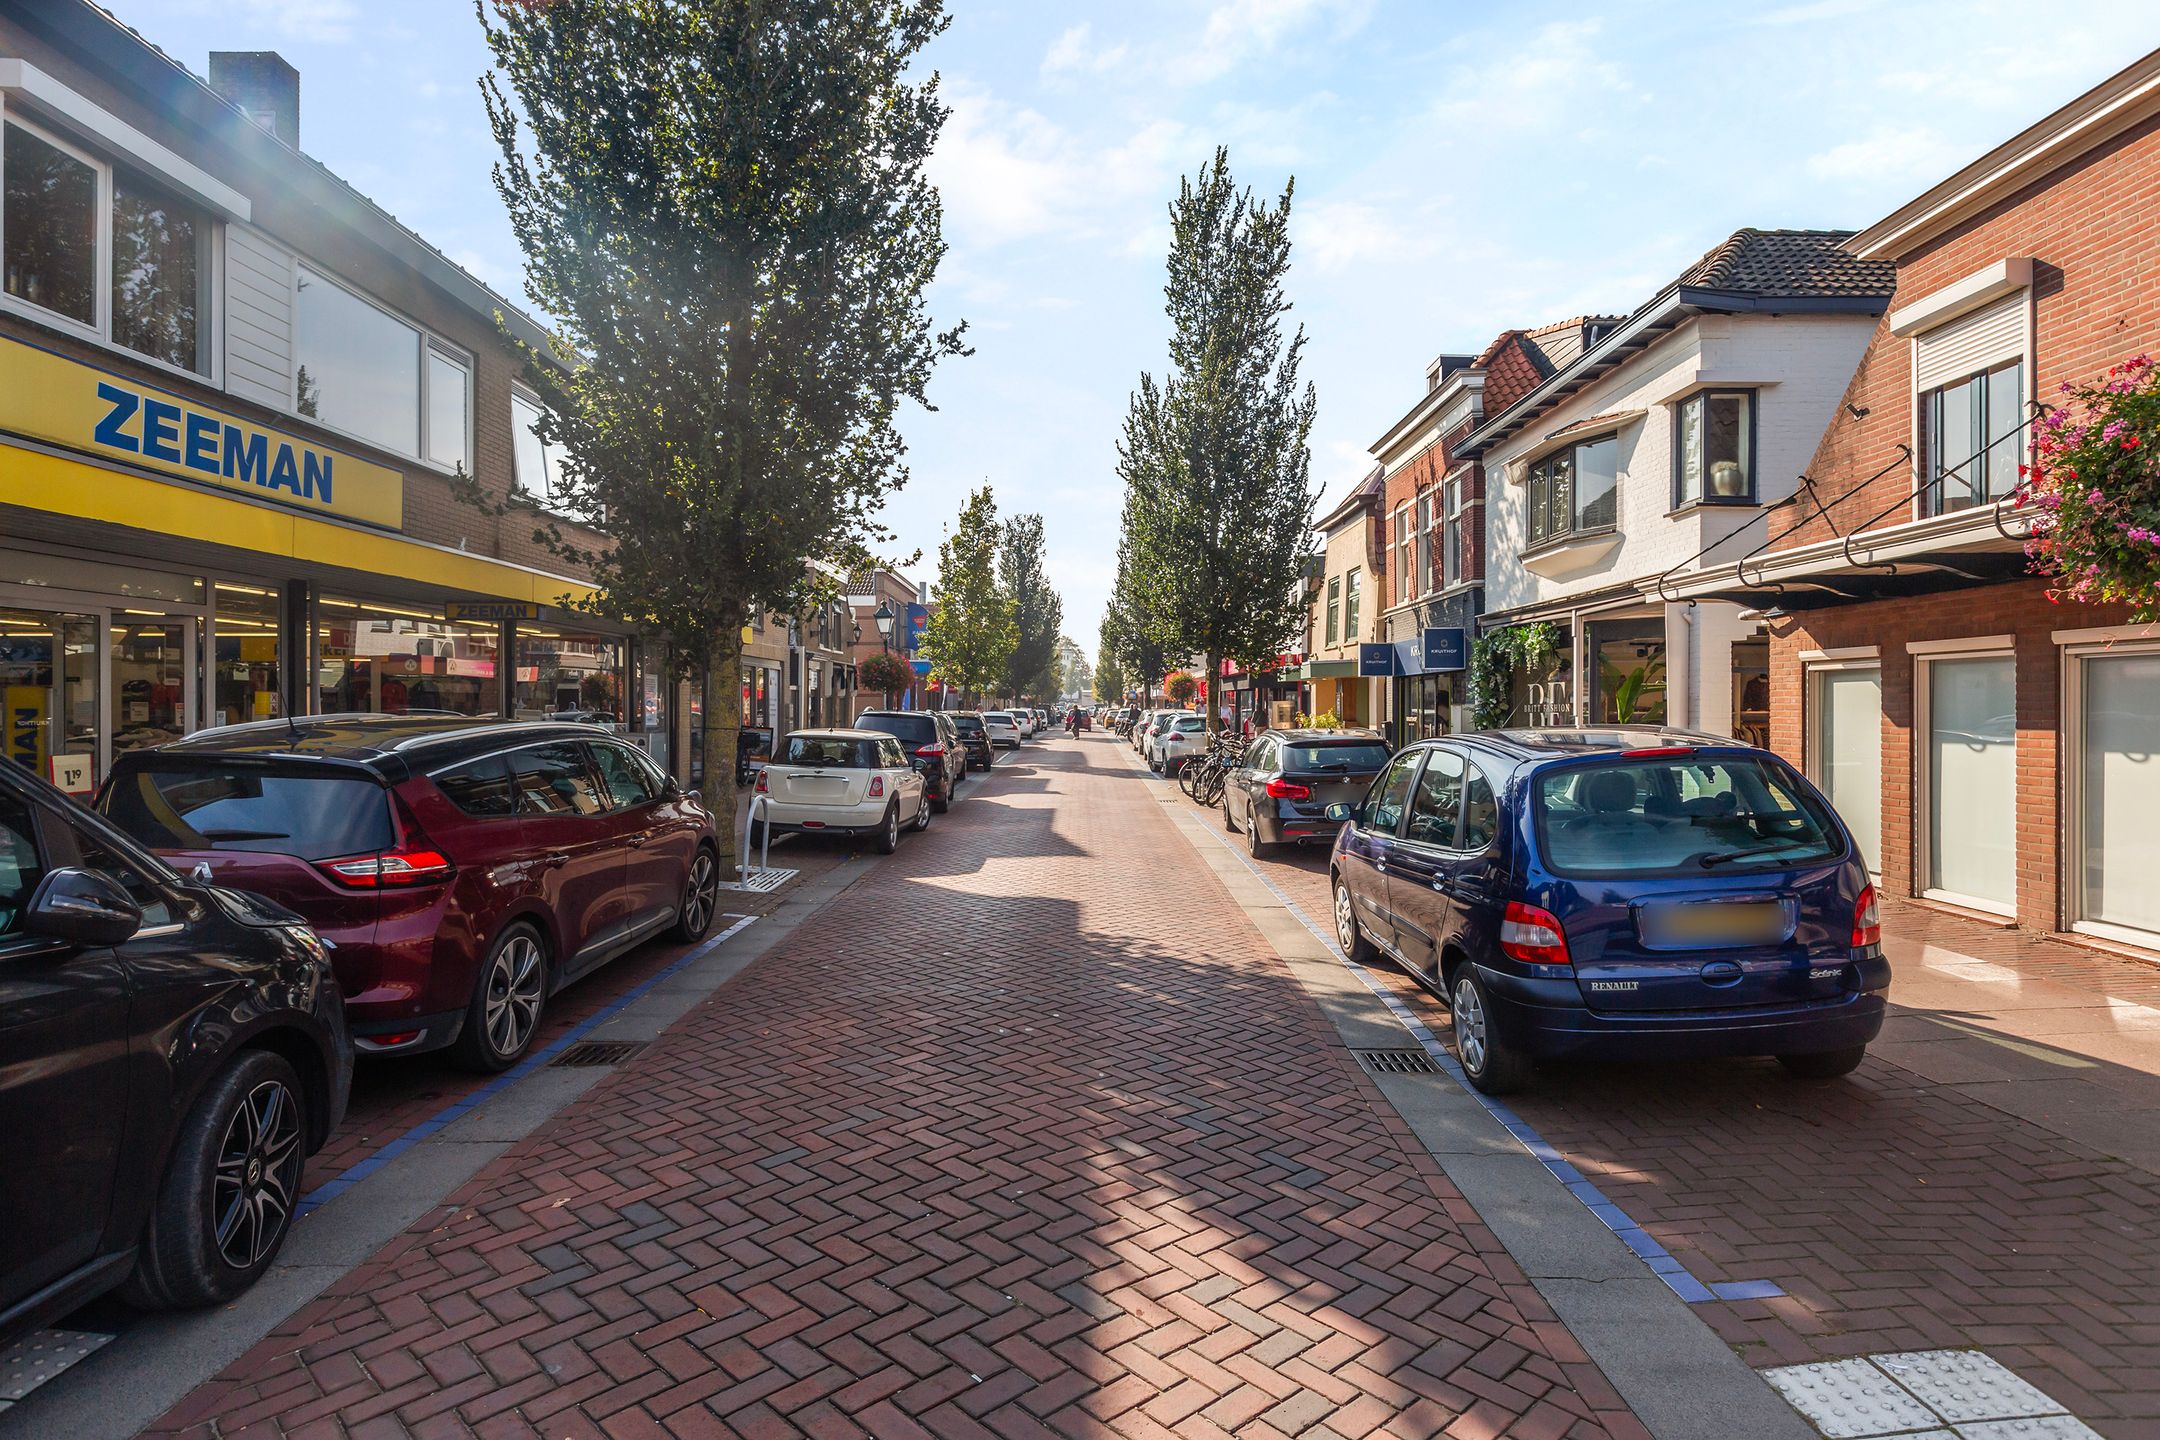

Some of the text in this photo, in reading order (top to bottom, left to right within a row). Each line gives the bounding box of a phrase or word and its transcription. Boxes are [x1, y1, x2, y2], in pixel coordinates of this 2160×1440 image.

[94, 381, 333, 504] ZEEMAN
[456, 604, 528, 618] ZEEMAN
[1523, 703, 1570, 713] BRITT FASHION
[64, 769, 82, 786] 1.19
[1591, 981, 1639, 991] RENAULT
